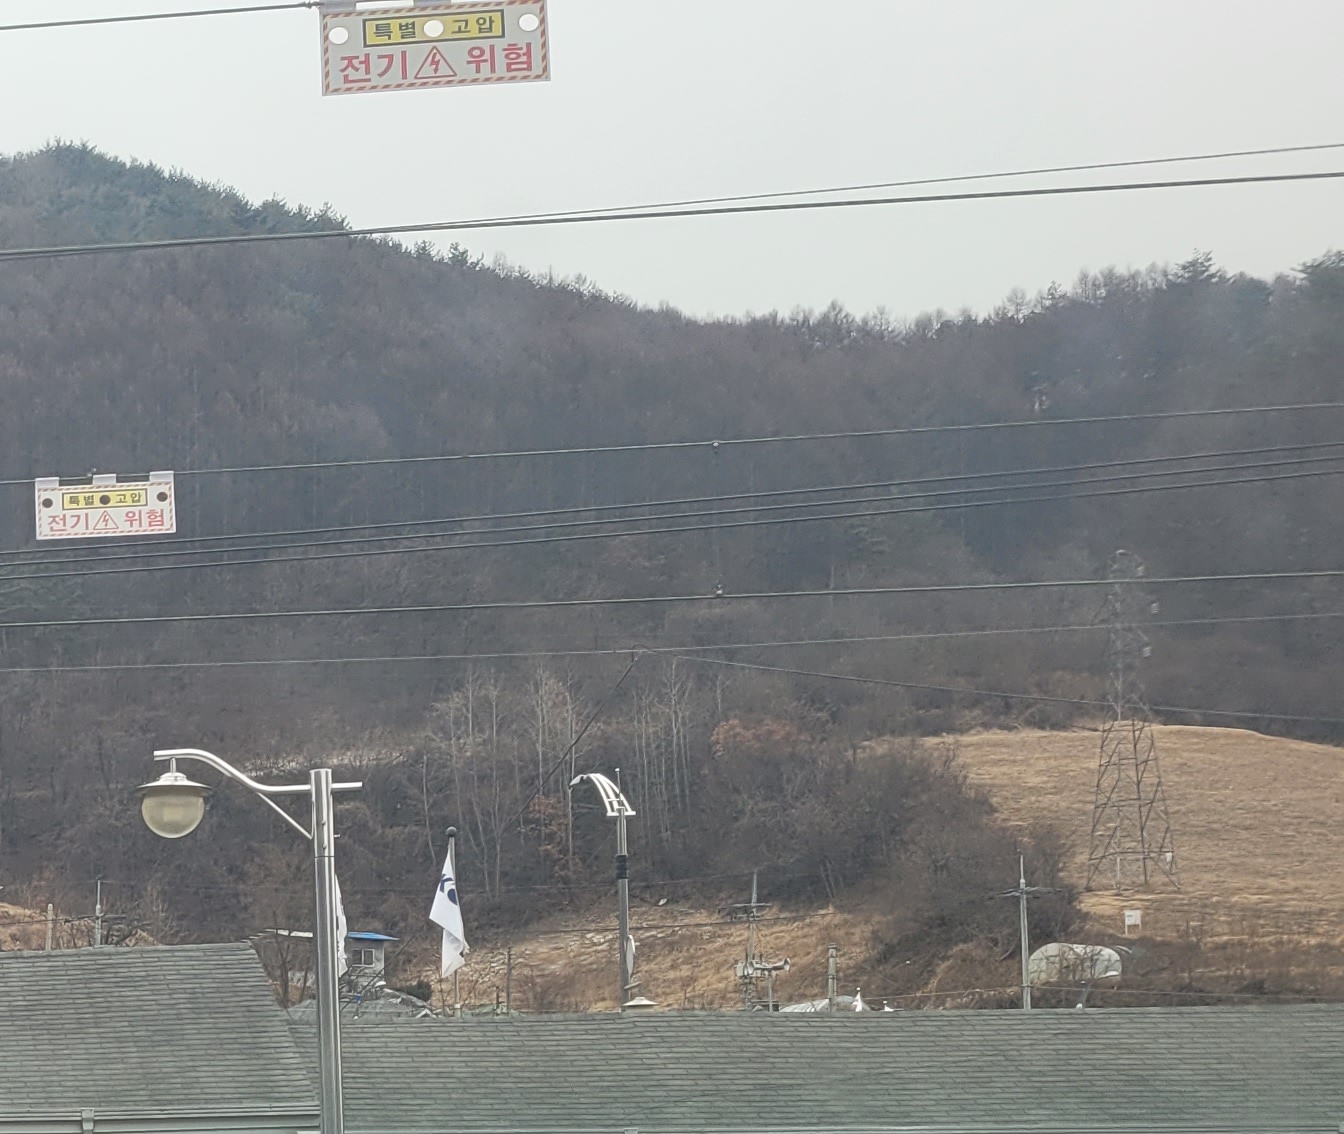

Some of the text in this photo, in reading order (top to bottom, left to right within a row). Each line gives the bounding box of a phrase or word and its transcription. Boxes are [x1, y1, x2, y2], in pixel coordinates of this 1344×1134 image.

[372, 15, 495, 41] 특별 고압
[339, 42, 533, 85] 전기 위험
[68, 494, 95, 507] 특별
[47, 508, 165, 533] 전기 위험
